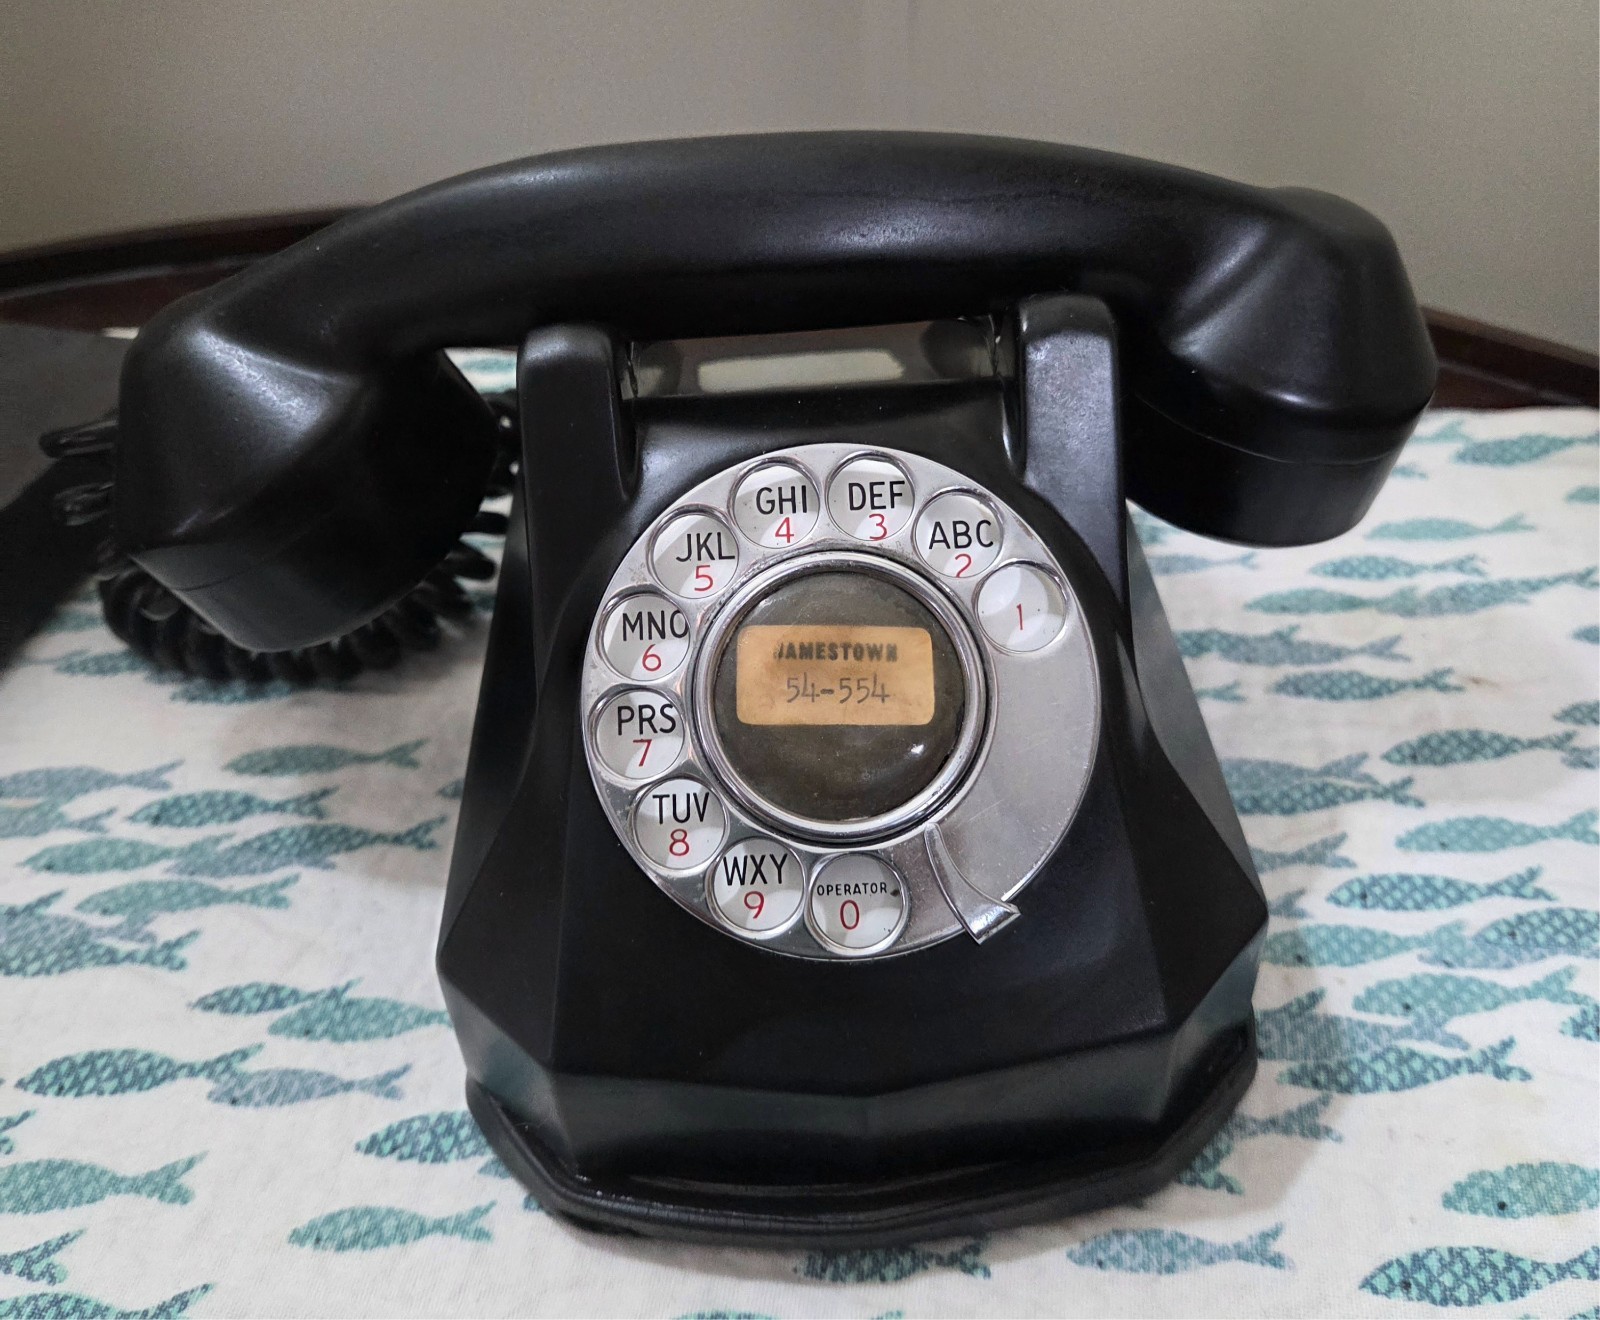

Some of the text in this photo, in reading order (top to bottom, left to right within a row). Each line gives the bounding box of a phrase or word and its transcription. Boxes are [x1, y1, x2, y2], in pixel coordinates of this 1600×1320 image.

[756, 485, 807, 515] GHI
[849, 480, 905, 511] DEF
[775, 517, 795, 543] 4
[868, 513, 888, 541] 3
[928, 519, 994, 550] ABC
[676, 532, 736, 562] JKL
[693, 565, 714, 592] 5
[954, 553, 972, 578] 2
[622, 609, 690, 642] MNO
[1016, 604, 1024, 631] 1
[642, 644, 662, 672] 6
[774, 641, 898, 663] JAMESTOWN
[786, 672, 890, 704] 54-554
[617, 703, 677, 736] PRS
[632, 738, 653, 767] 7
[652, 792, 710, 825] TUV
[669, 828, 690, 856] 8
[723, 853, 788, 886] WXY
[816, 882, 888, 897] OPERATOR
[743, 891, 765, 919] 9
[840, 899, 860, 930] 0
